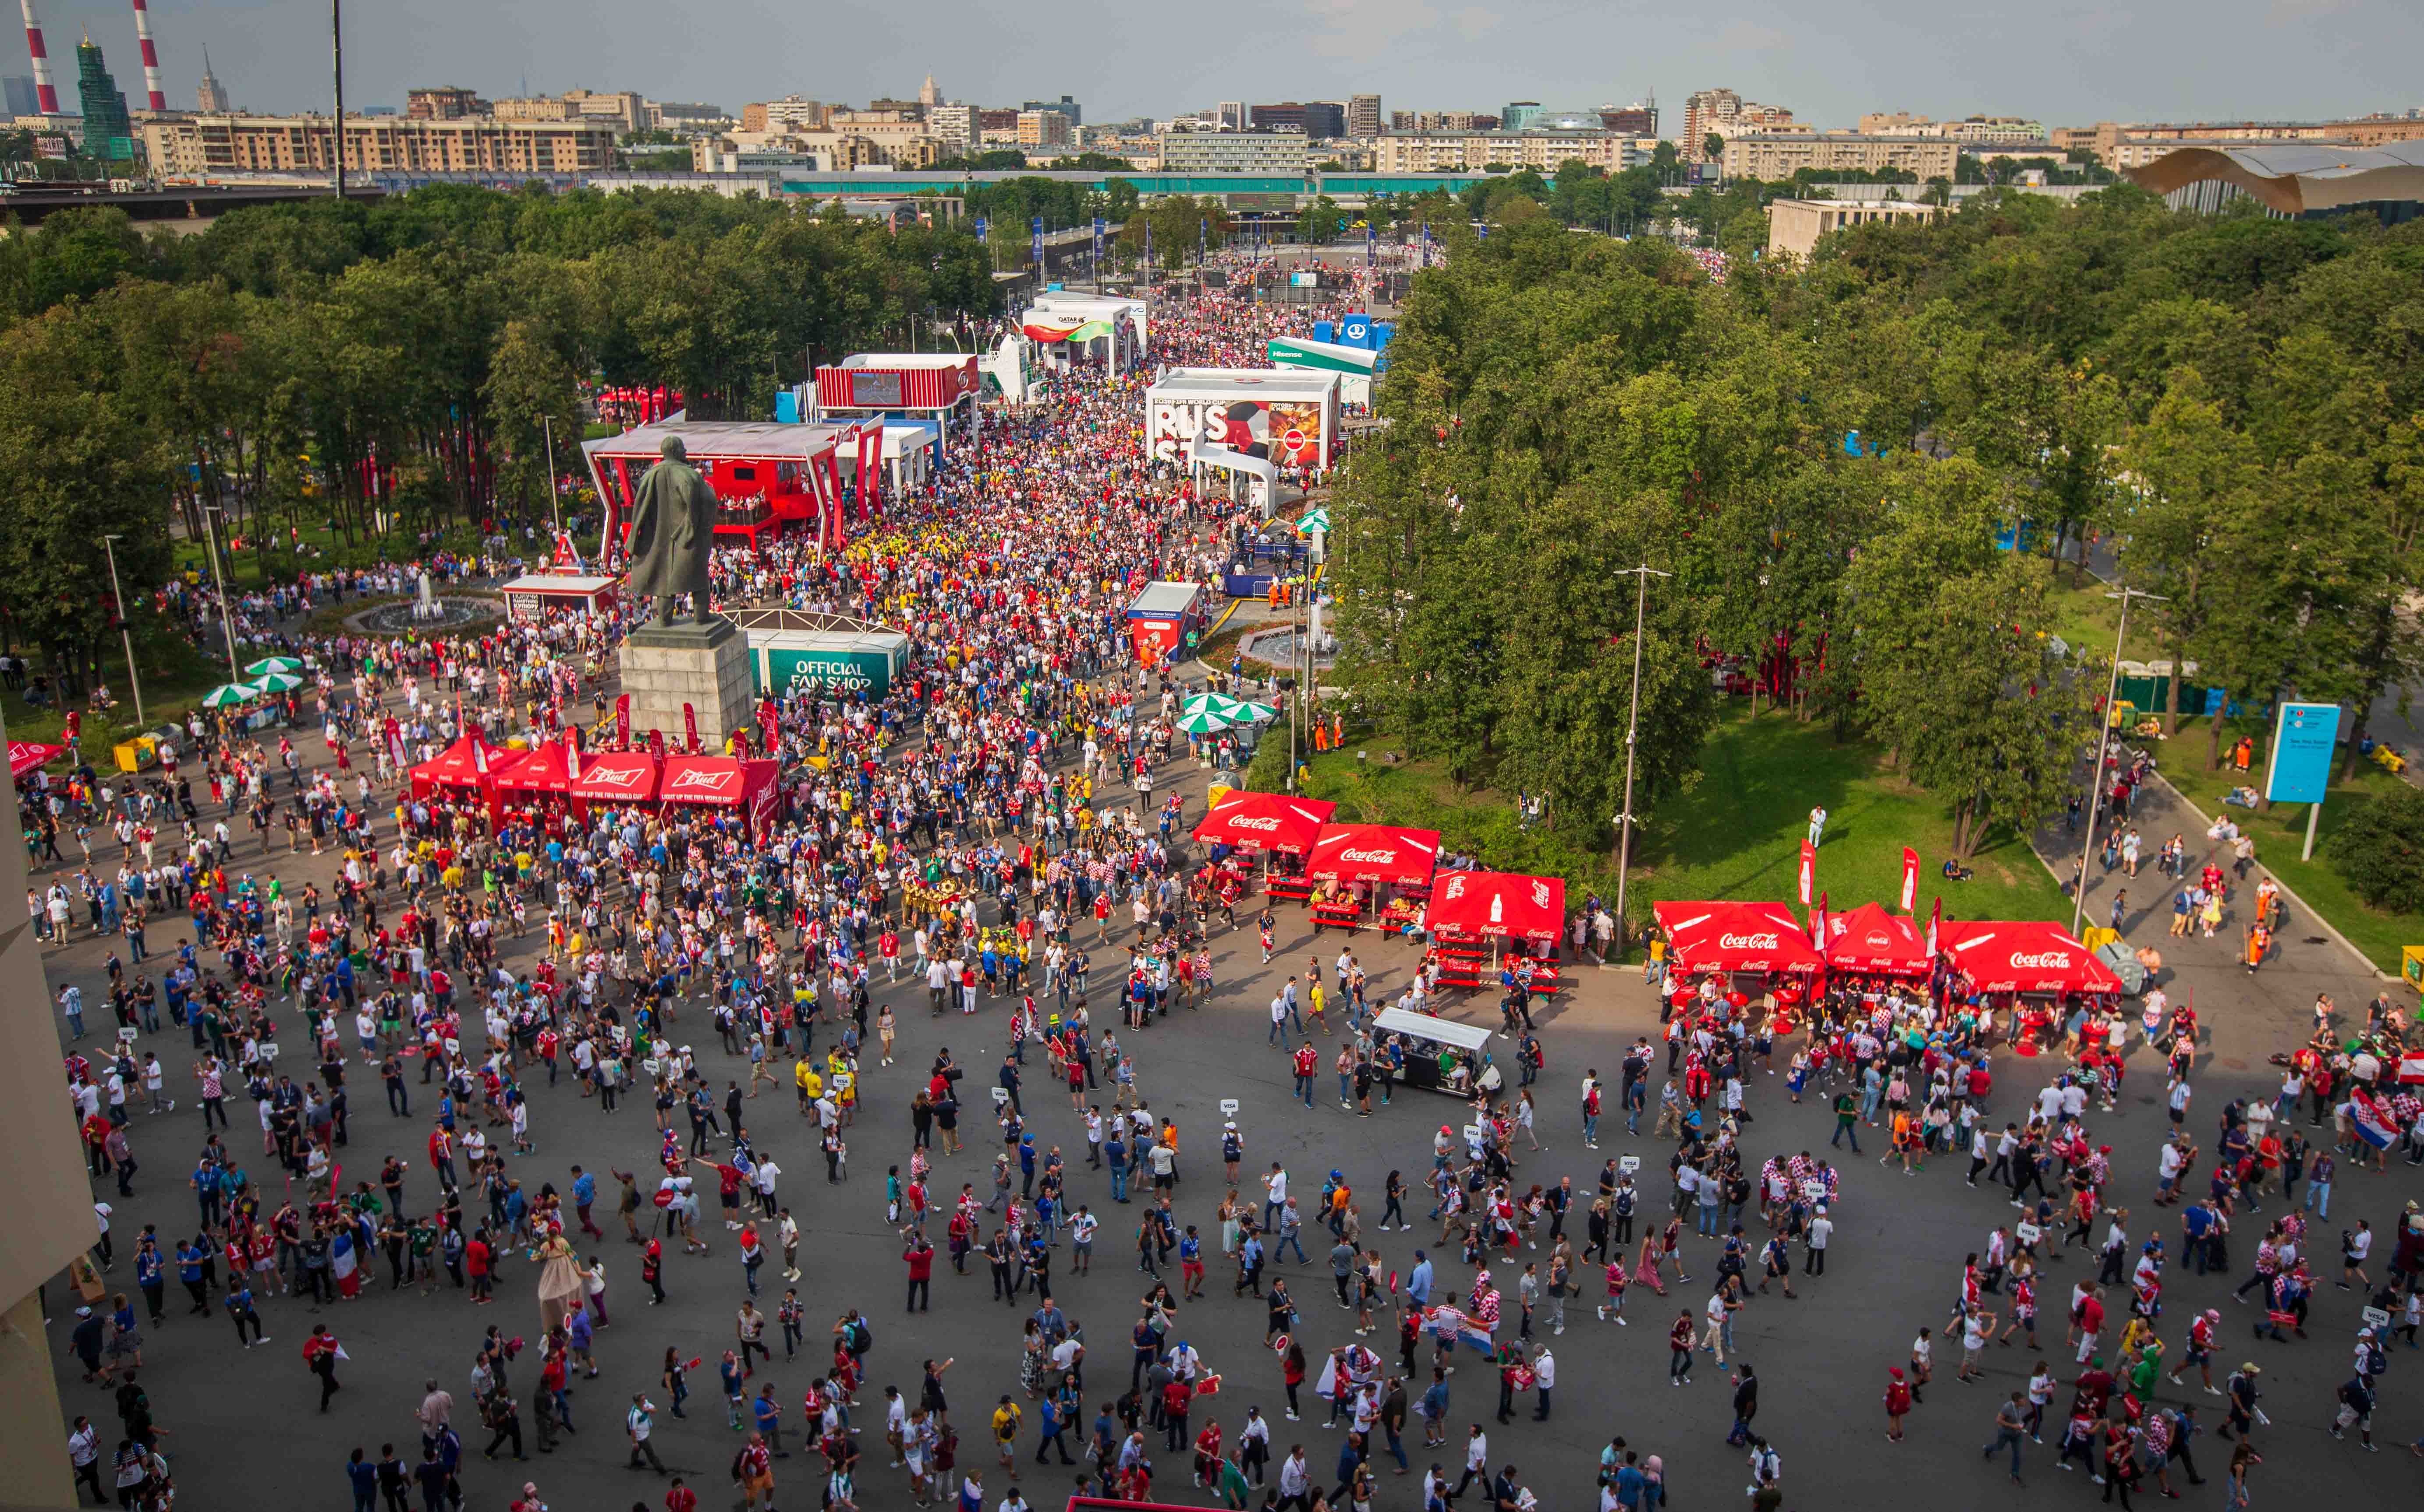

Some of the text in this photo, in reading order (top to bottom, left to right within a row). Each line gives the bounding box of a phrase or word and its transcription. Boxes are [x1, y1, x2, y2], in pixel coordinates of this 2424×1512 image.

[796, 660, 865, 676] OFFICIAL
[791, 674, 872, 690] FAN SHOP
[596, 768, 630, 782] Bud
[685, 771, 719, 785] Bud
[1228, 814, 1283, 831] Coca-Cola
[1199, 834, 1223, 843] Coca-Cola
[1238, 838, 1262, 847] Coca-Cola
[1277, 843, 1301, 853] Coca-Cola
[1340, 848, 1398, 864] Coca-Cola
[1313, 871, 1338, 880] Coca-Cola
[1355, 872, 1381, 881] Coca-Cola
[1398, 875, 1423, 885] Coca-Cola
[1434, 922, 1461, 931] Coca-Cola
[1480, 925, 1508, 934] Coca-Cola
[1527, 929, 1556, 938] Coca-Cola
[1720, 932, 1779, 950] Coca-Cola
[2010, 951, 2071, 968] Coca-Cola
[1693, 961, 1722, 970] Coca-Cola
[1741, 960, 1770, 970] Coca-Cola
[1788, 961, 1816, 972] Coca-Cola
[1987, 980, 2015, 991] Coca-Cola
[2035, 980, 2064, 991] Coca-Cola
[2084, 981, 2113, 991] Coca-Cola
[2367, 1311, 2385, 1322] VISA
